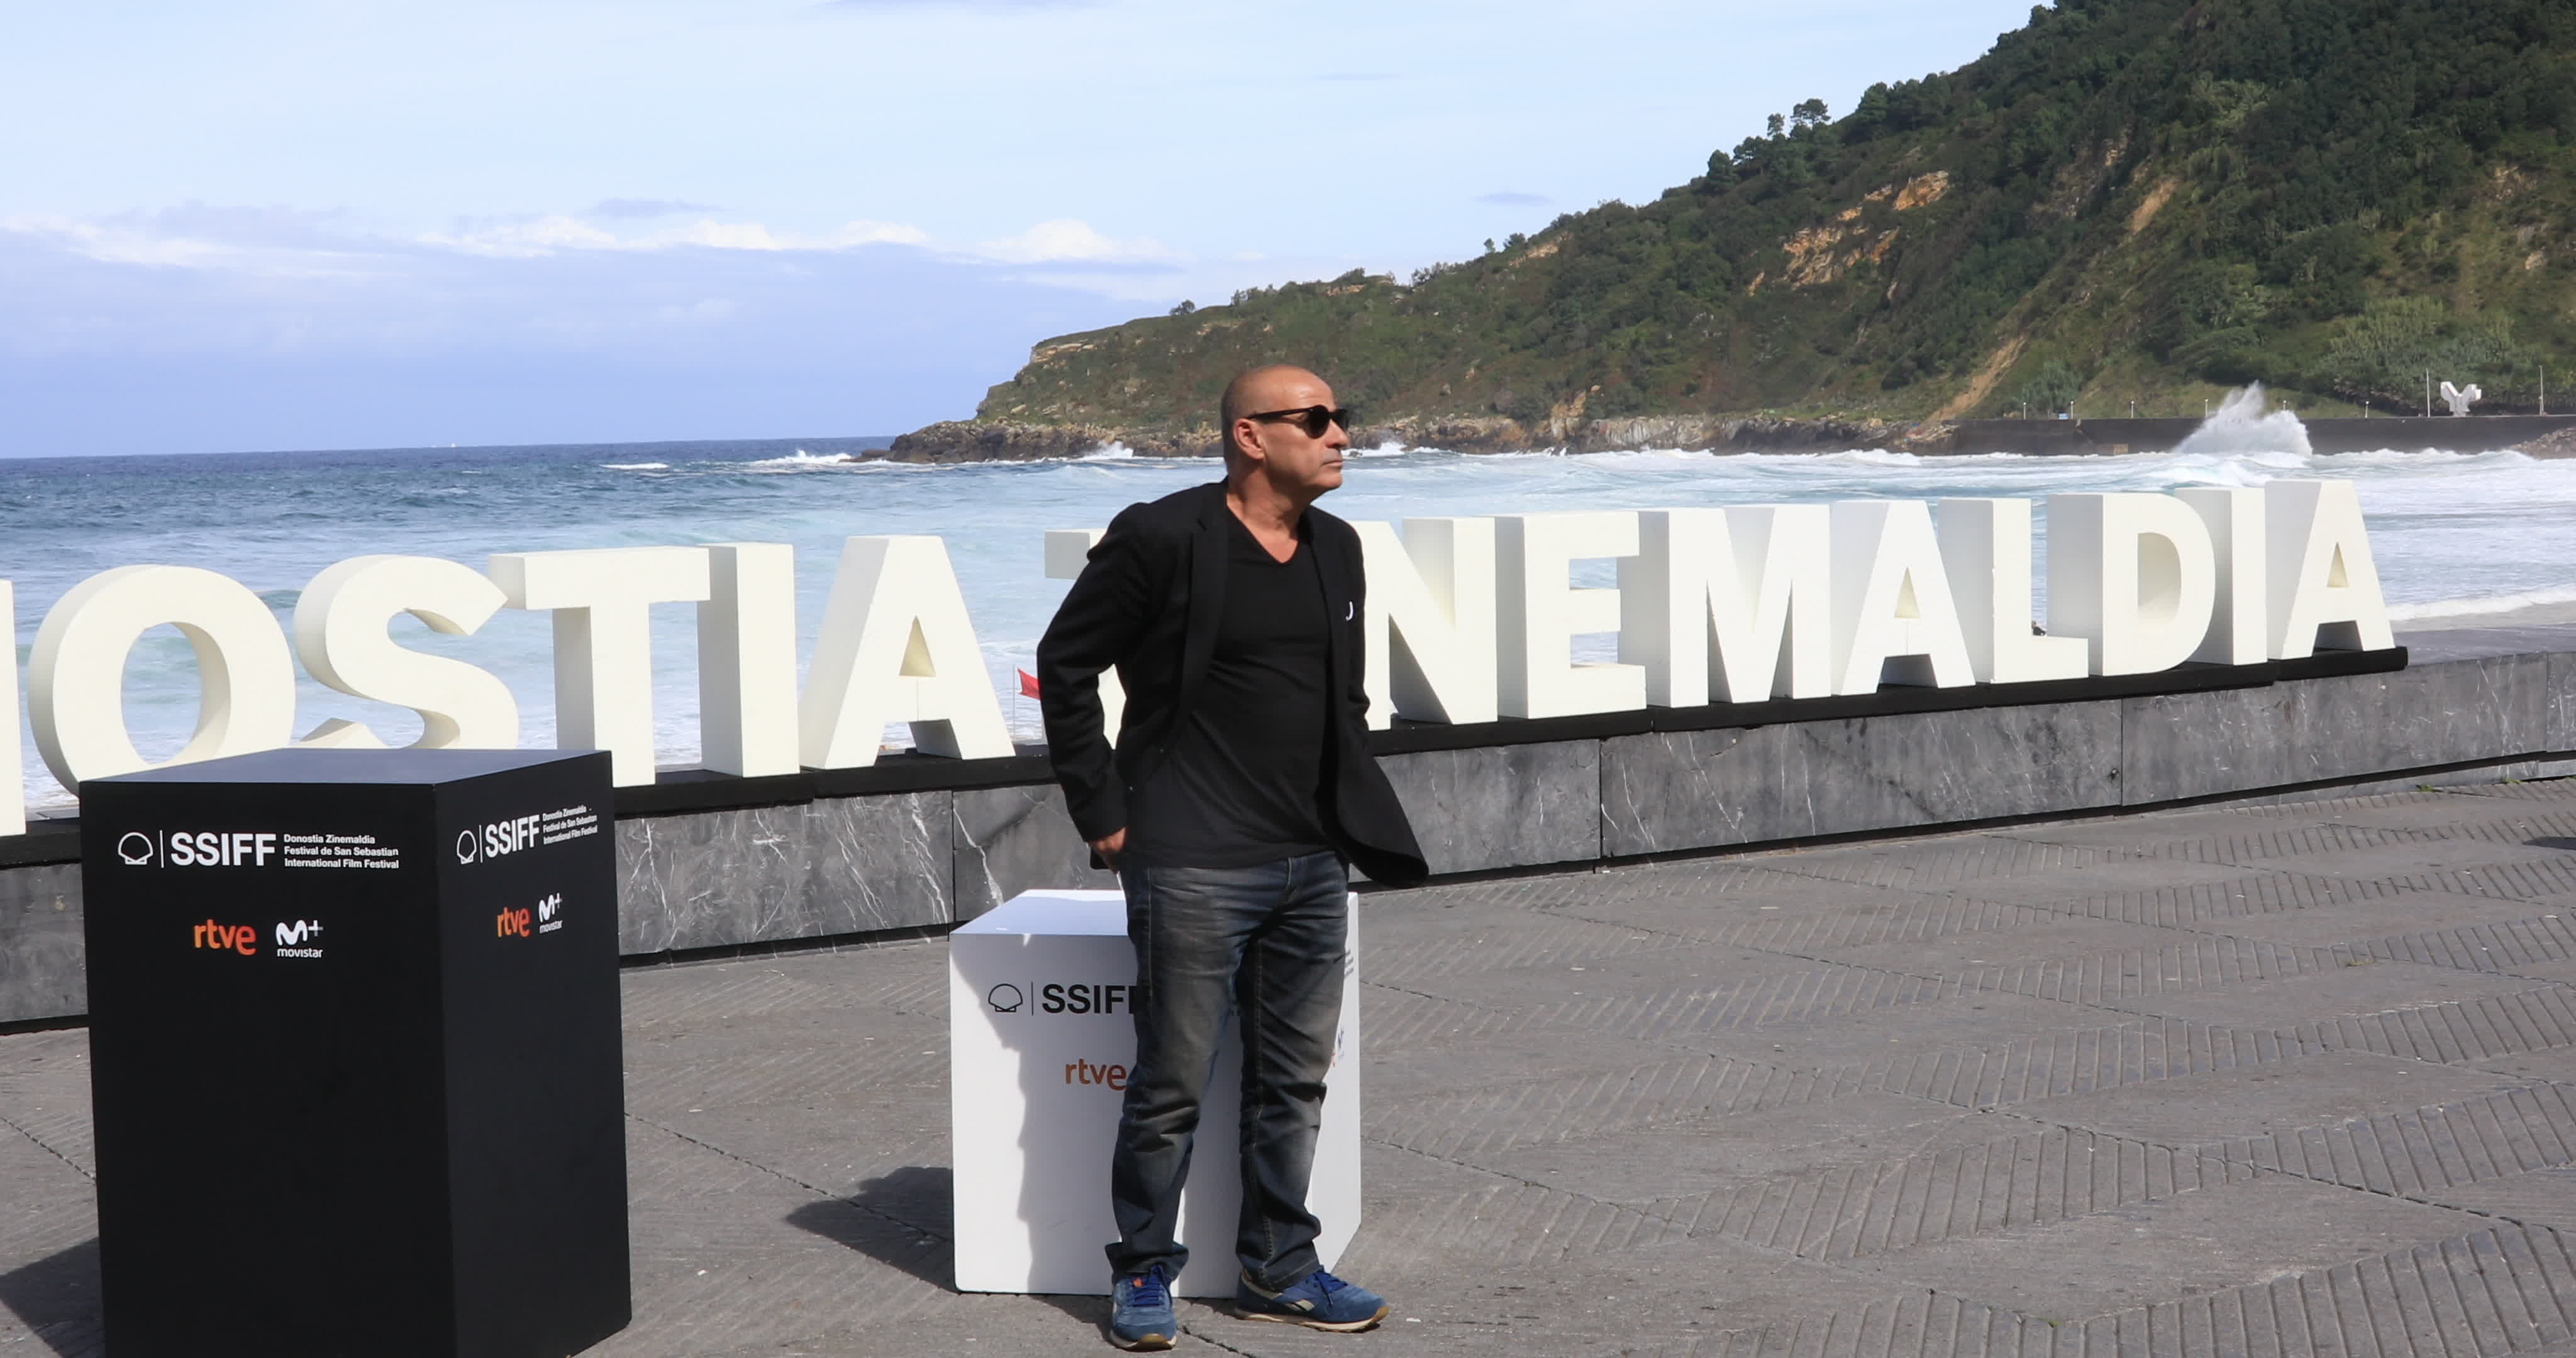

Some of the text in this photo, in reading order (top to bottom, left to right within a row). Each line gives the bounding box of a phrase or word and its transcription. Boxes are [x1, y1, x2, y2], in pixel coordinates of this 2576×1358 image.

[0, 534, 1016, 836] OSTIA
[170, 832, 277, 866] SSIFF
[284, 834, 375, 844] Donostia Zinemaldia
[485, 814, 540, 858] SSIFF
[284, 846, 399, 857] Festival de San Sebastian
[284, 858, 399, 869] International Film Festival
[497, 907, 531, 937] rtve
[539, 919, 563, 934] movistar
[194, 919, 257, 956] rtve
[277, 947, 323, 959] movistar
[1065, 1058, 1128, 1091] rtve
